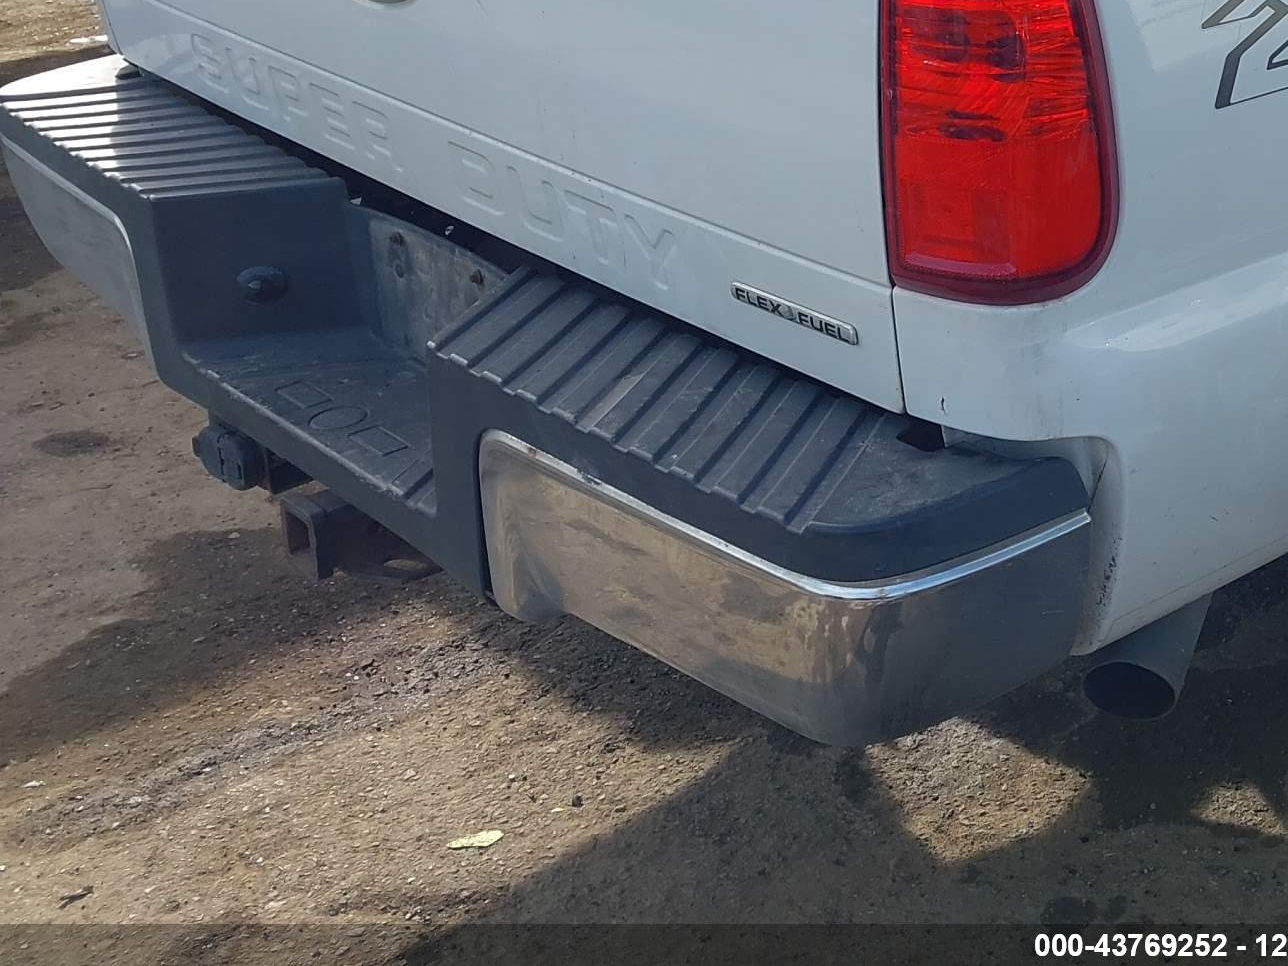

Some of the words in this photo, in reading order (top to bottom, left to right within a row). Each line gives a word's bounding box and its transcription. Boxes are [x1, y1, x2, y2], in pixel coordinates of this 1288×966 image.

[190, 33, 404, 172] SUPER
[448, 140, 677, 291] DUTY
[734, 287, 785, 318] FLEX
[797, 311, 851, 344] FUEL
